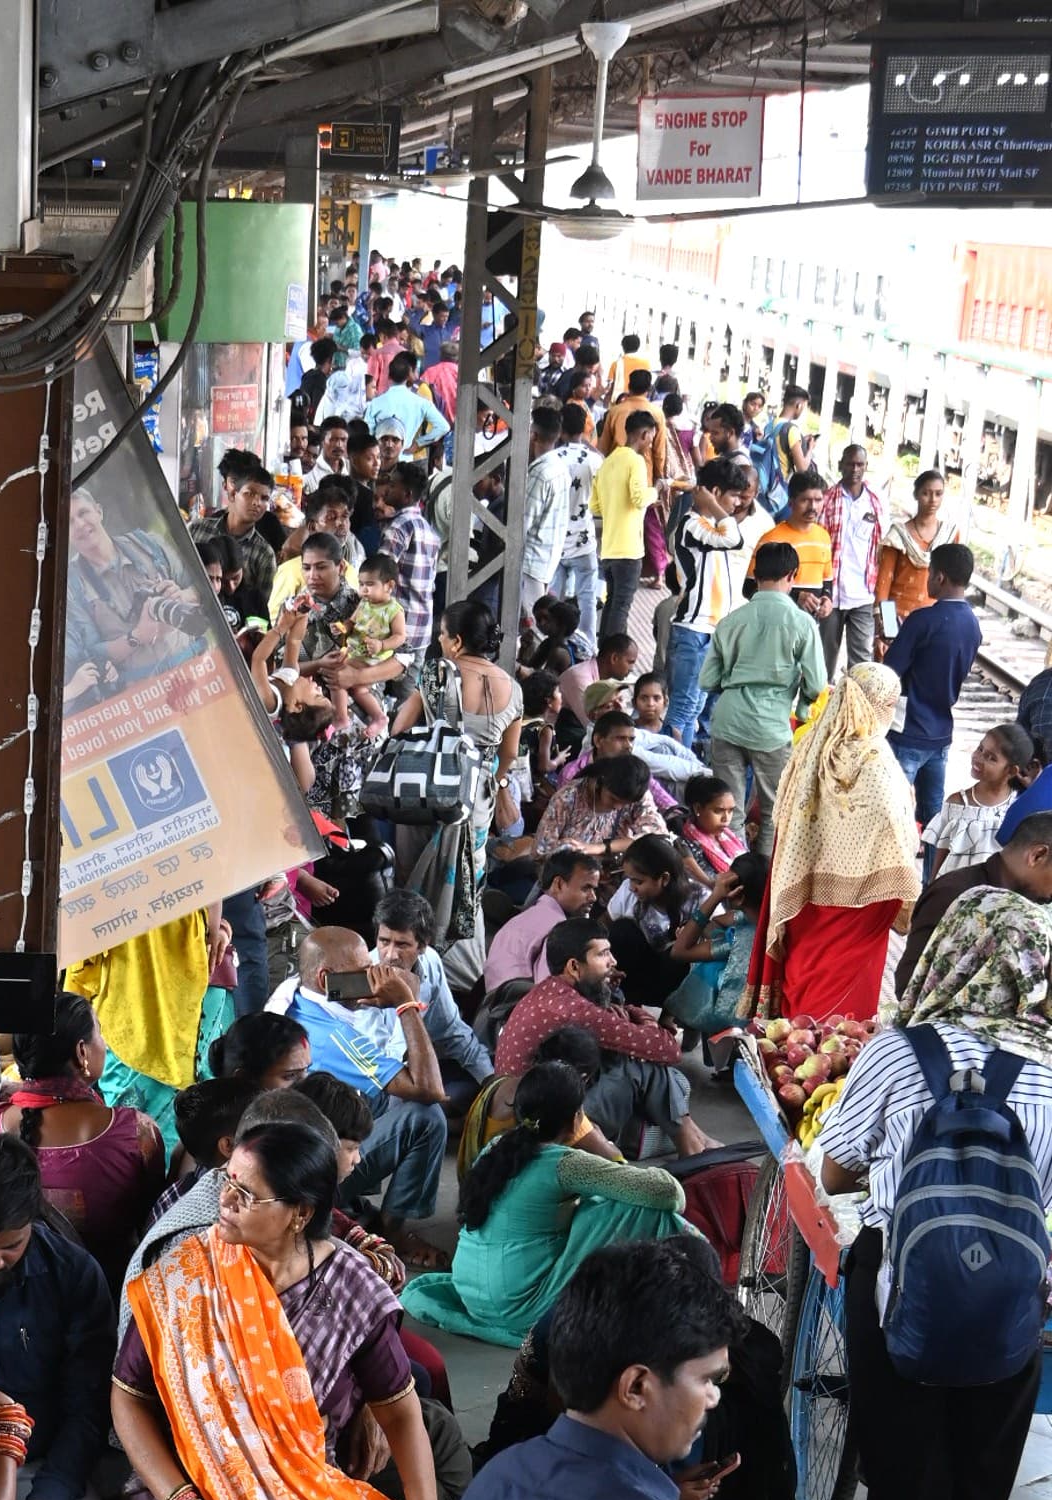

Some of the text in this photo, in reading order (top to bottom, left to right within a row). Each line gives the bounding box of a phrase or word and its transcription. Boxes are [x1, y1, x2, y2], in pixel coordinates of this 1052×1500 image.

[654, 110, 748, 130] ENGINE STOP
[961, 126, 990, 136] PURI
[992, 126, 1008, 136] SF
[689, 140, 712, 157] For
[924, 140, 966, 150] KORBA
[968, 140, 992, 150] ASR
[922, 154, 949, 164] DGG
[951, 154, 974, 164] BSP
[975, 154, 1004, 164] Local
[646, 166, 753, 186] VANDE BHARAT
[920, 168, 964, 178] Mumbai
[966, 168, 998, 178] HWH
[998, 168, 1022, 178] Mail
[1024, 168, 1040, 178] SF
[919, 182, 946, 192] HYD
